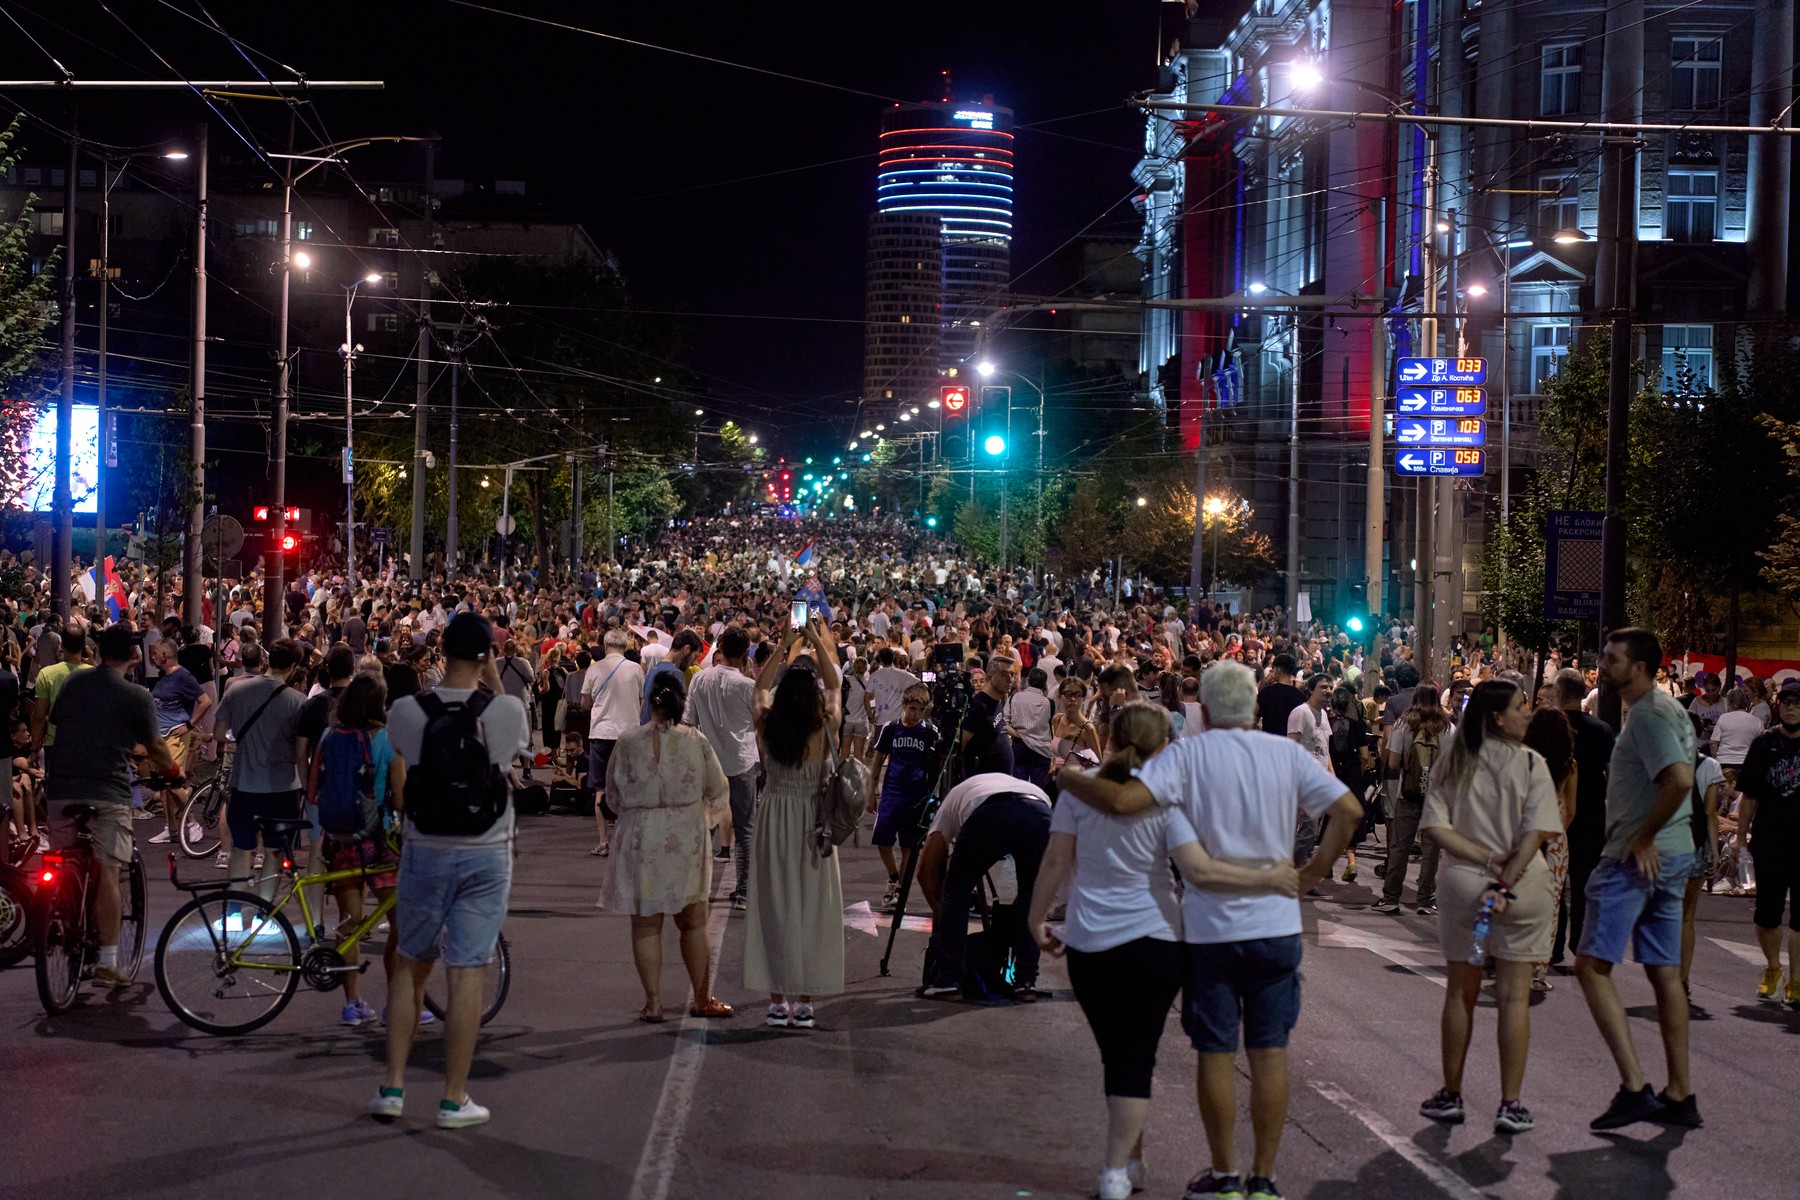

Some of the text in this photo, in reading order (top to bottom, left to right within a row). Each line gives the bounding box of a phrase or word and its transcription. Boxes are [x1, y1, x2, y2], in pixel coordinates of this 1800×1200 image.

[1457, 360, 1482, 373] 033
[1456, 390, 1482, 404] 063
[1461, 420, 1481, 434] 103
[1455, 451, 1480, 464] 058
[1430, 465, 1459, 475] Славија
[1555, 515, 1602, 527] НЕ БЛОКИ
[1558, 527, 1604, 537] РАСКРСНИ
[1573, 598, 1601, 607] BLOKIR
[892, 737, 925, 751] ADIDAS
